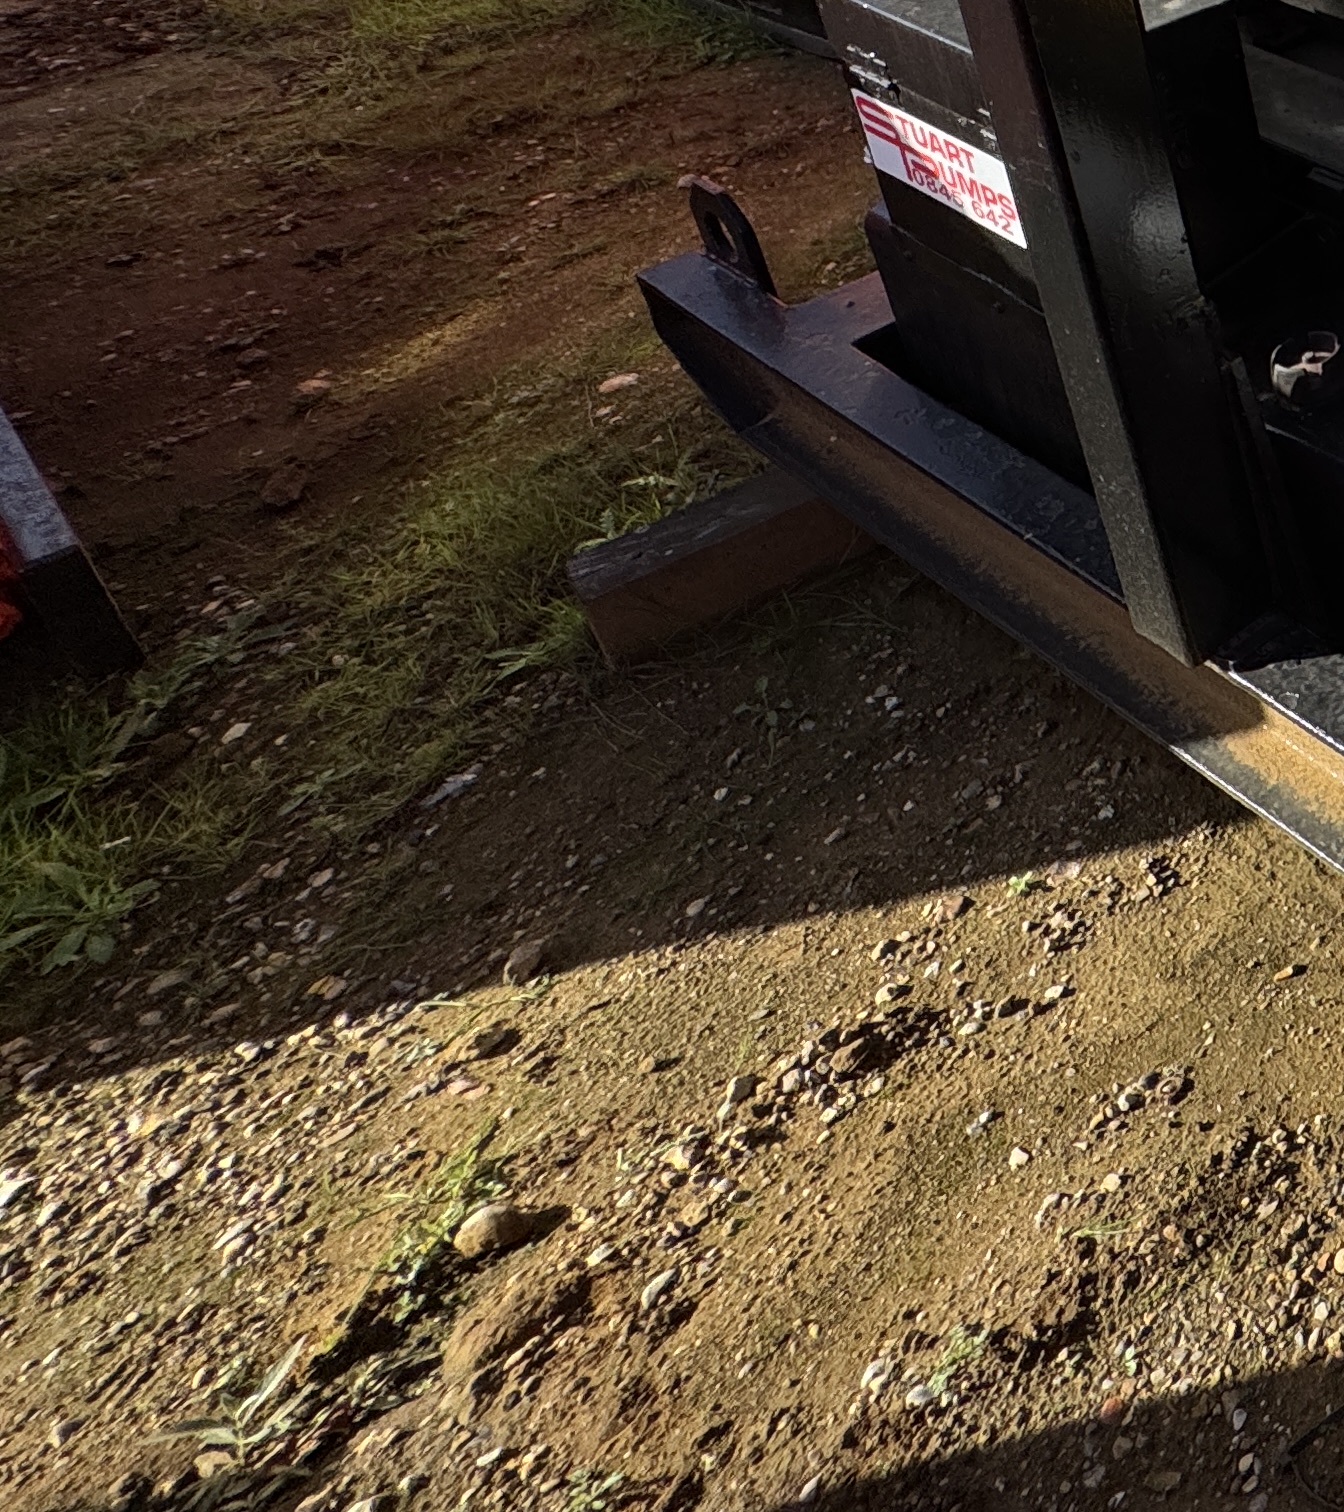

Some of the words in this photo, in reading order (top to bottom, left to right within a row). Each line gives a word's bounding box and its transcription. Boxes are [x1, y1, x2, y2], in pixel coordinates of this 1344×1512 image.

[856, 95, 976, 175] STUART
[864, 123, 1016, 221] PUMPS
[971, 199, 1015, 236] 642
